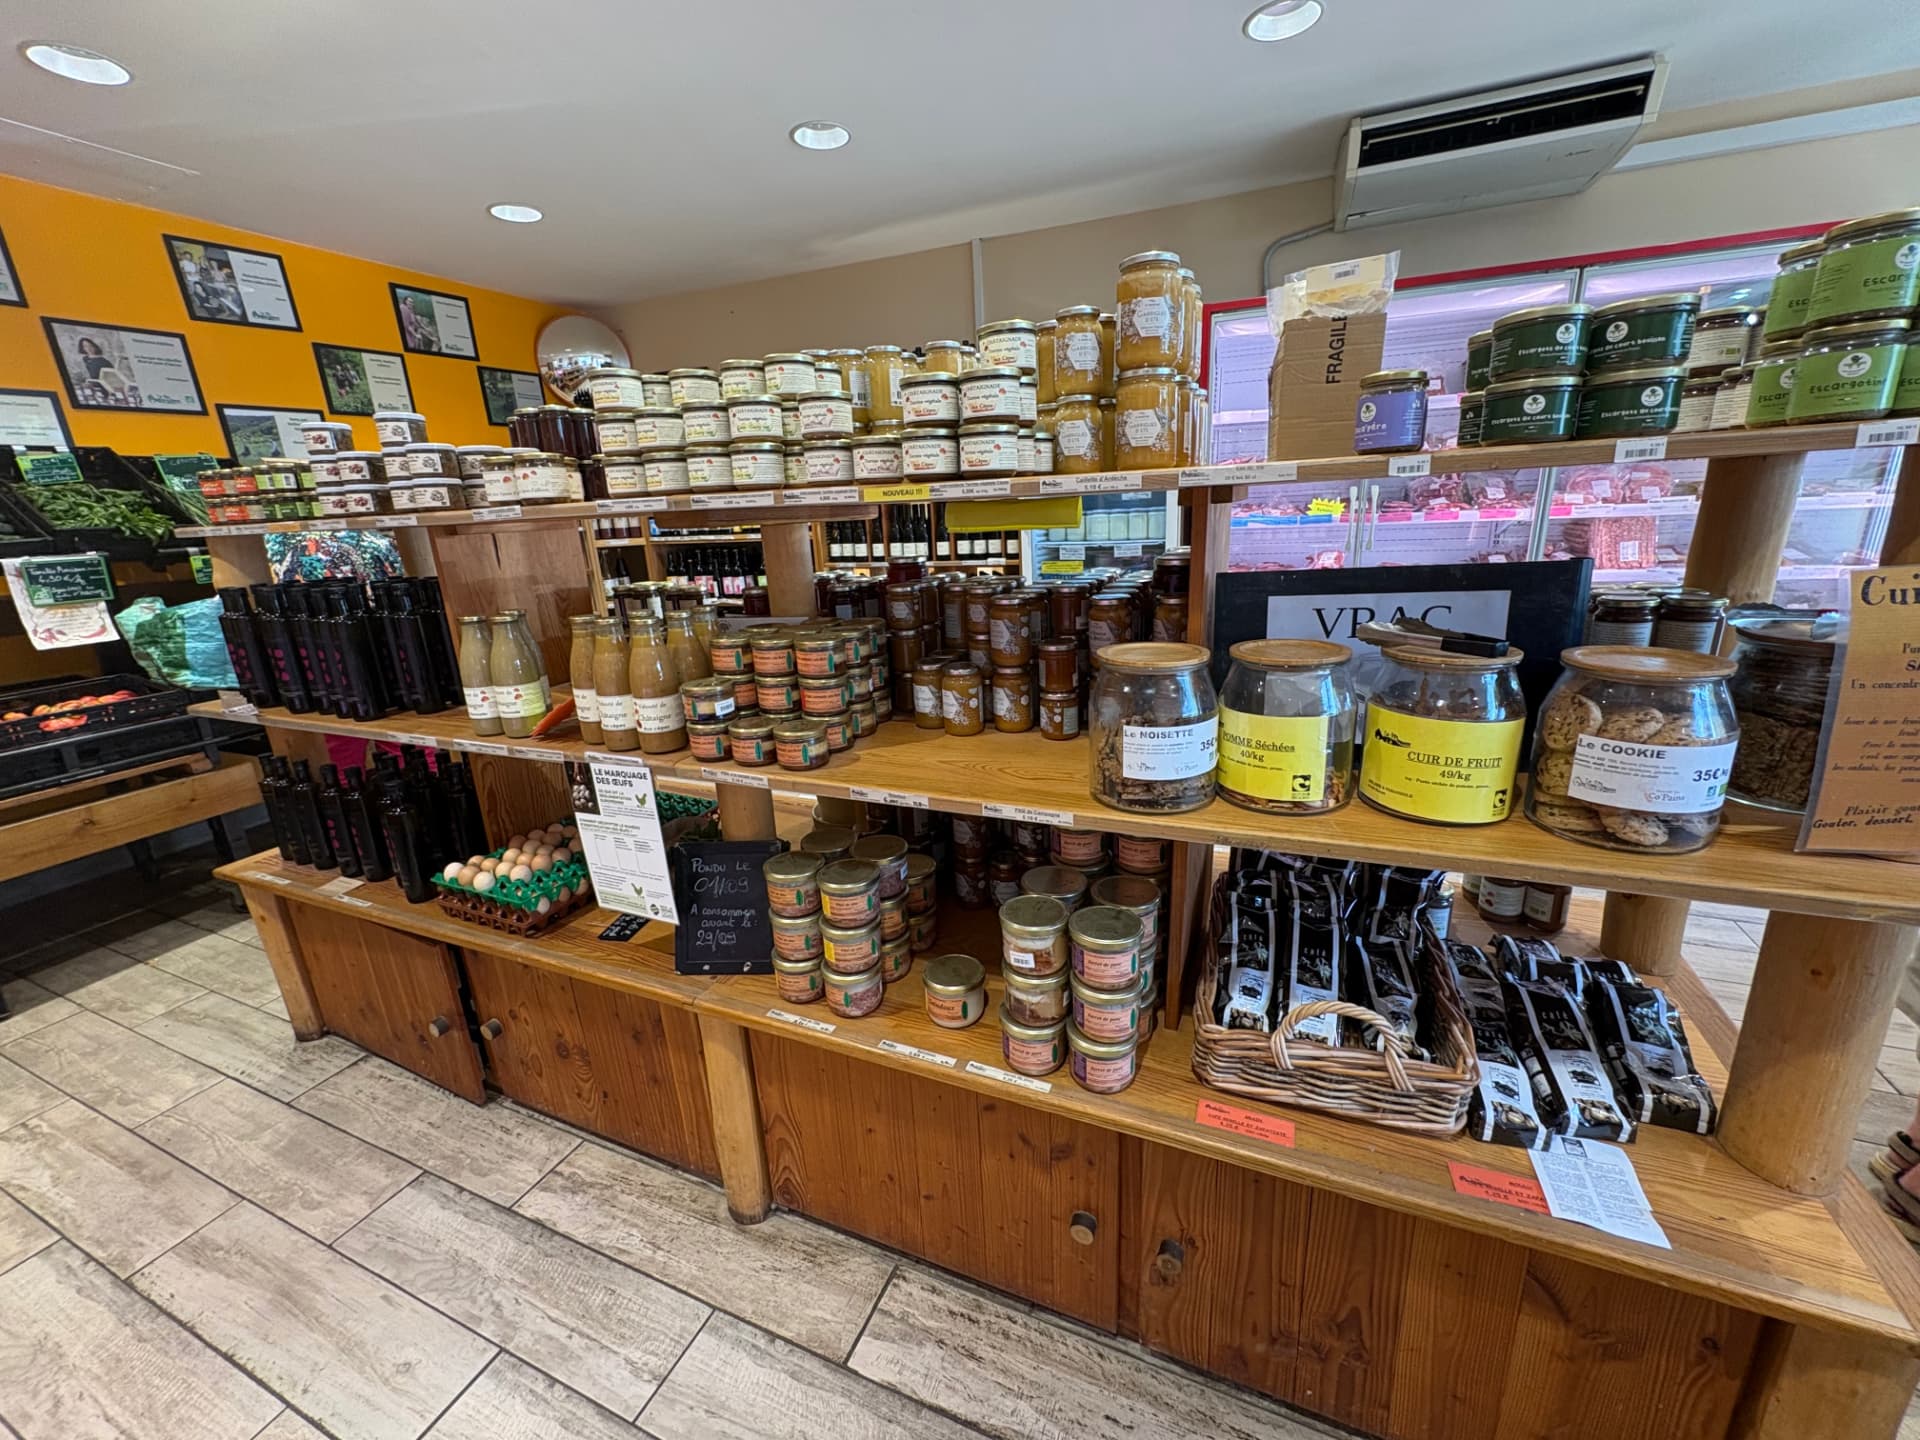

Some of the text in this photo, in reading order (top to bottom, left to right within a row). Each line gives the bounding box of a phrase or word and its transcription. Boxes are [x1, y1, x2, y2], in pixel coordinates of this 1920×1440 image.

[1325, 316, 1348, 385] FRAGILE
[882, 489, 914, 497] NOUVEAU
[1872, 679, 1920, 689] concentr
[1139, 728, 1194, 740] NOISETTE
[1255, 740, 1295, 753] Séchées
[1577, 738, 1668, 760] Le COOKIE
[1240, 749, 1265, 762] 40/kg
[1407, 750, 1502, 769] CUIR DE FRUIT
[594, 768, 648, 780] LE MARQUAGE
[1439, 769, 1472, 782] 49/kg
[596, 777, 633, 787] DES ŒUFS
[1844, 804, 1889, 816] Plaisir
[690, 857, 752, 873] PONDU LE
[694, 875, 749, 898] 01/09
[690, 903, 756, 917] A consommer
[701, 916, 735, 928] avant
[696, 929, 737, 952] 29/09
